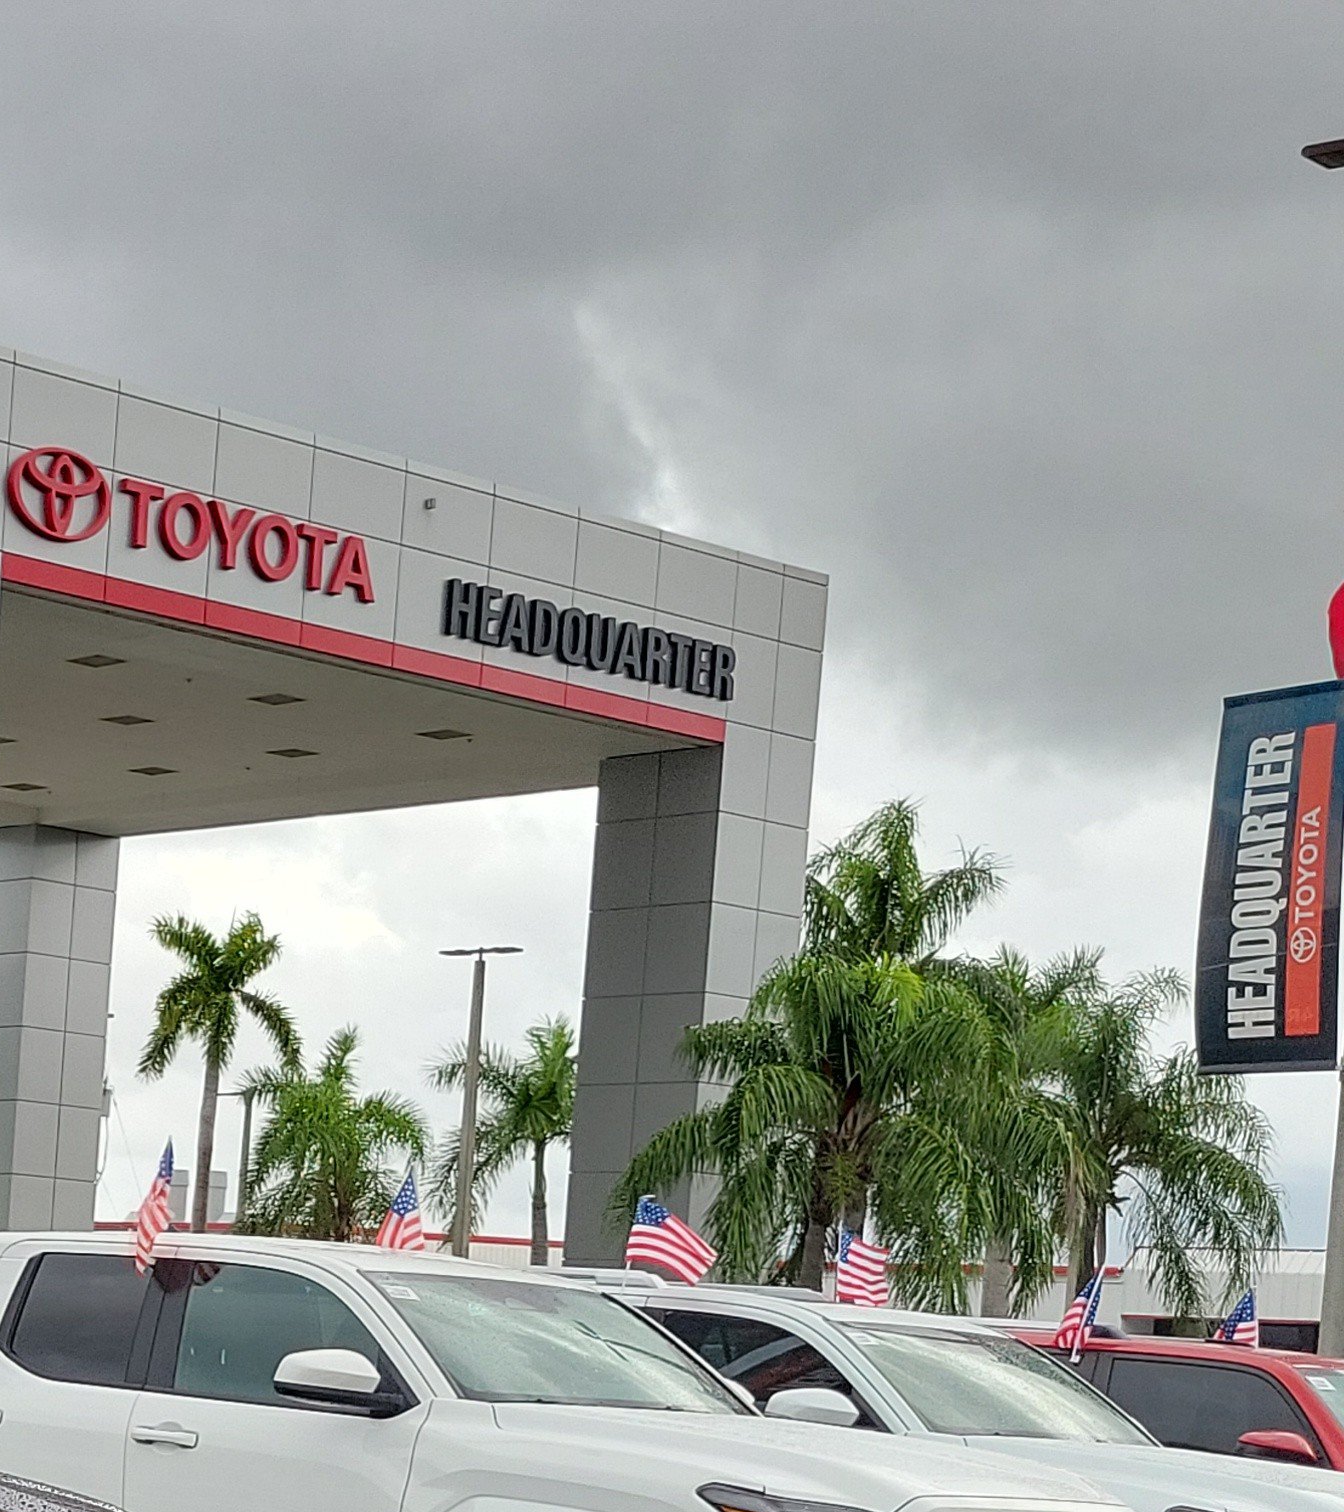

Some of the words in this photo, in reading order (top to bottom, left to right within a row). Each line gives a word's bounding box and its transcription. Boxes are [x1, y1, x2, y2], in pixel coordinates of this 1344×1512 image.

[118, 478, 375, 604] TOYOTA
[441, 577, 737, 701] HEADQUARTER
[1227, 730, 1296, 1040] HEADQUARTER
[1294, 805, 1322, 925] TOYOTA
